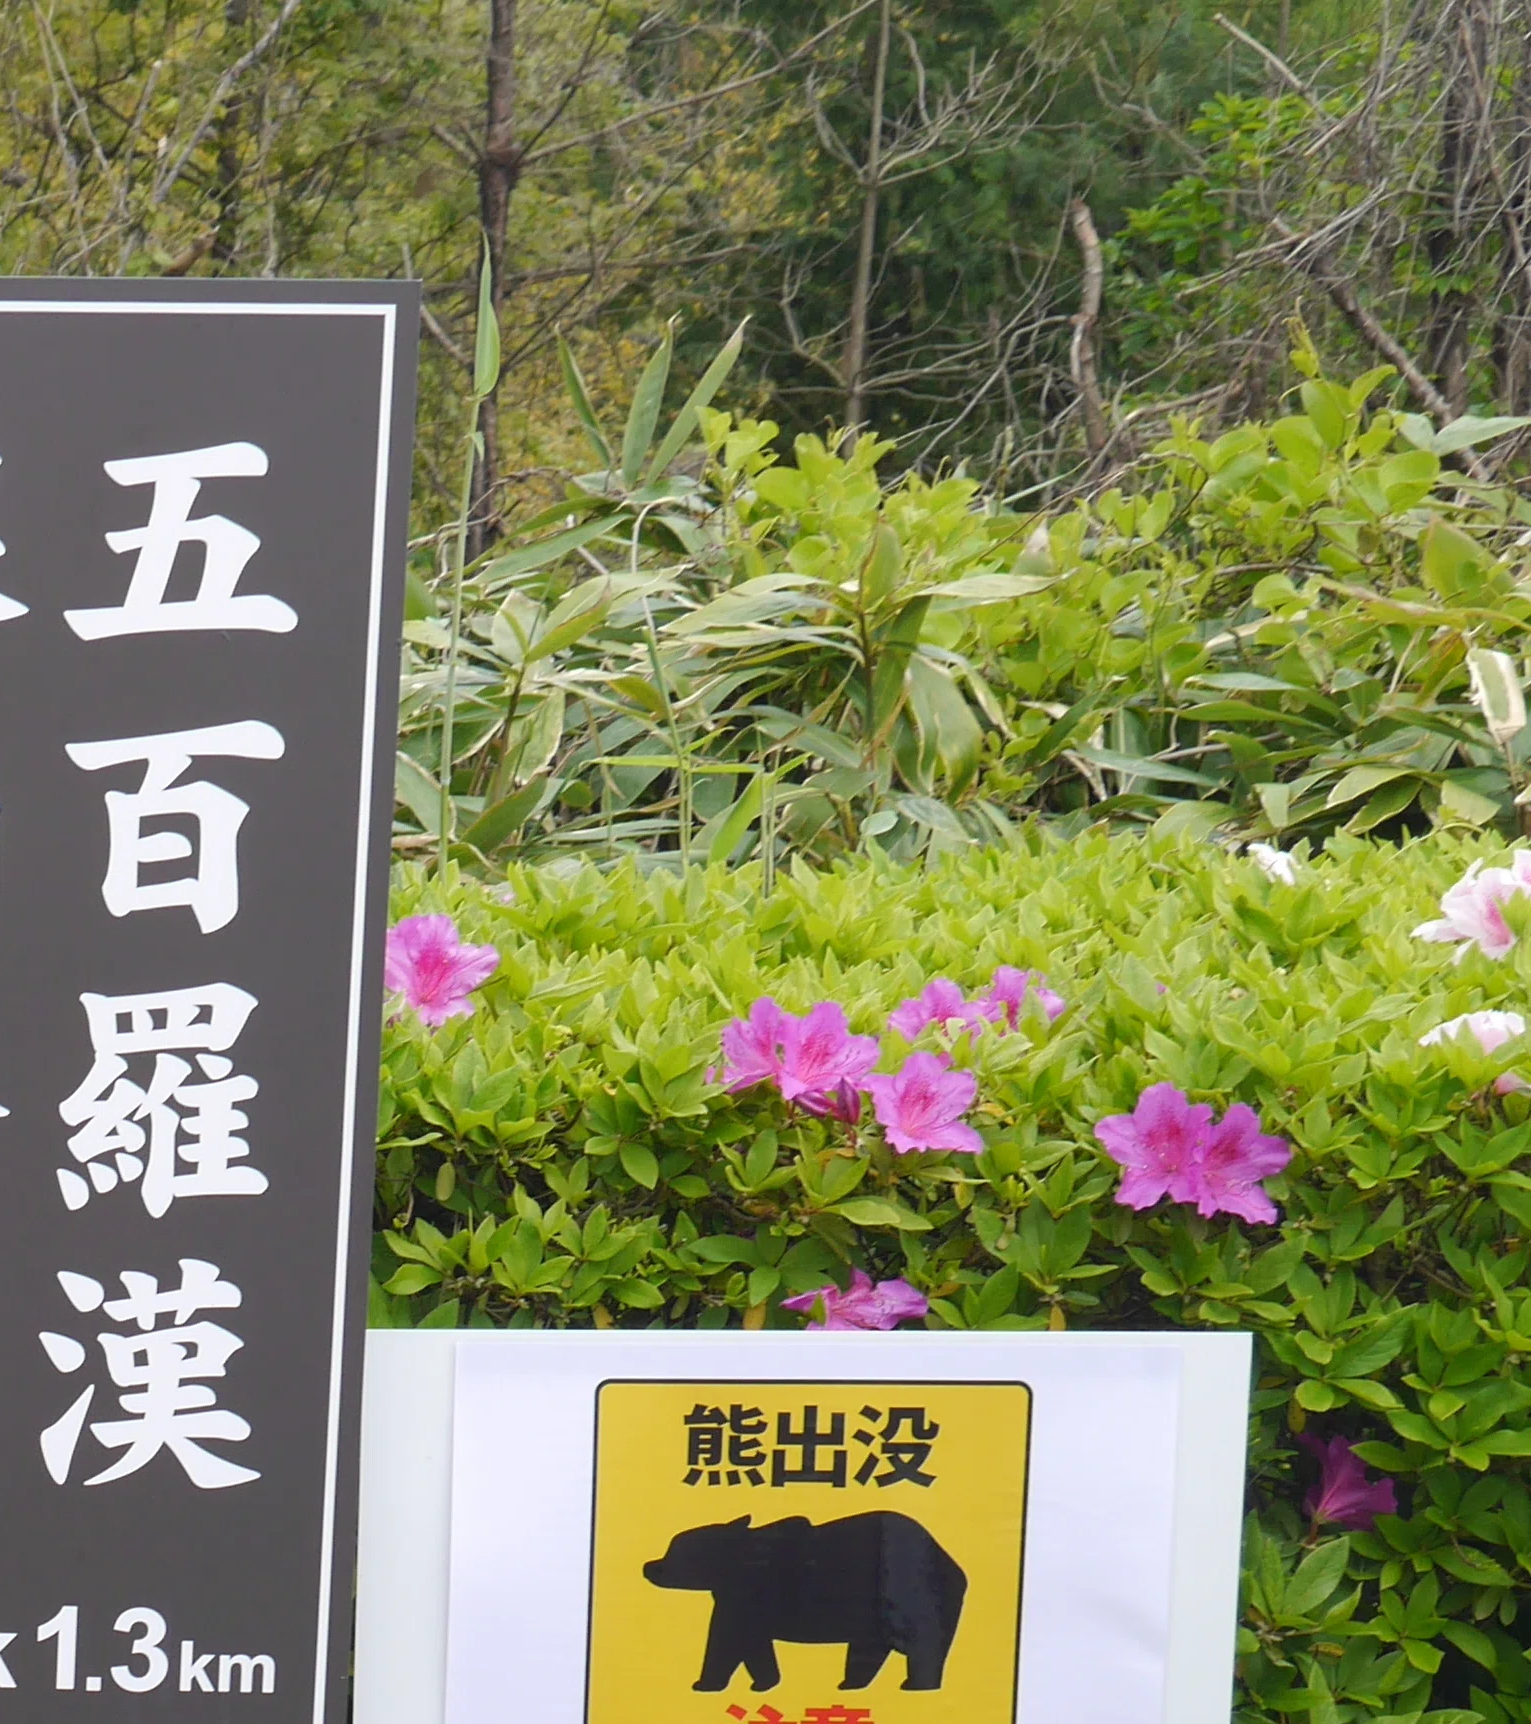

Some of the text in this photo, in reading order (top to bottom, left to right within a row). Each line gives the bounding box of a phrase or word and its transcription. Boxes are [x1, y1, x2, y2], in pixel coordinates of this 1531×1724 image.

[38, 441, 299, 1491] 五百羅漢
[682, 1403, 940, 1489] 熊出没
